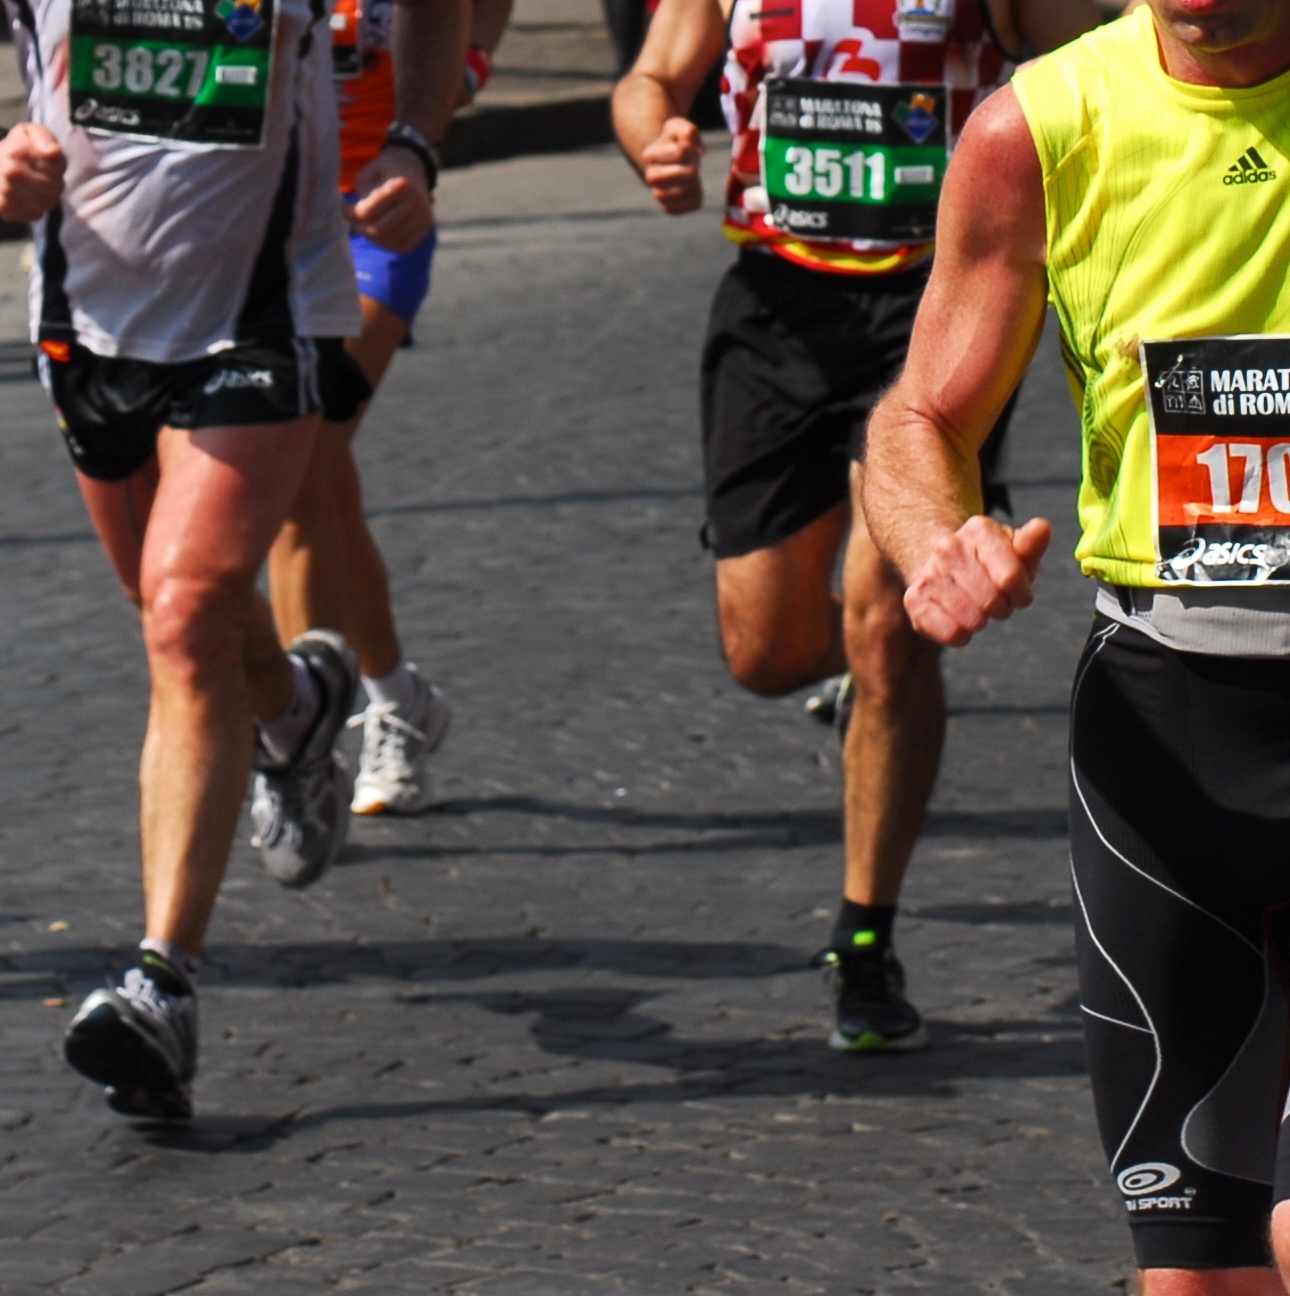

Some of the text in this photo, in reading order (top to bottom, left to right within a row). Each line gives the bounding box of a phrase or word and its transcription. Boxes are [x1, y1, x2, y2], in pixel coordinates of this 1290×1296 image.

[93, 44, 210, 98] 3827
[784, 146, 886, 200] 3511
[1222, 170, 1277, 185] adidas
[1213, 393, 1235, 415] di
[1138, 1196, 1192, 1210] SPORT
